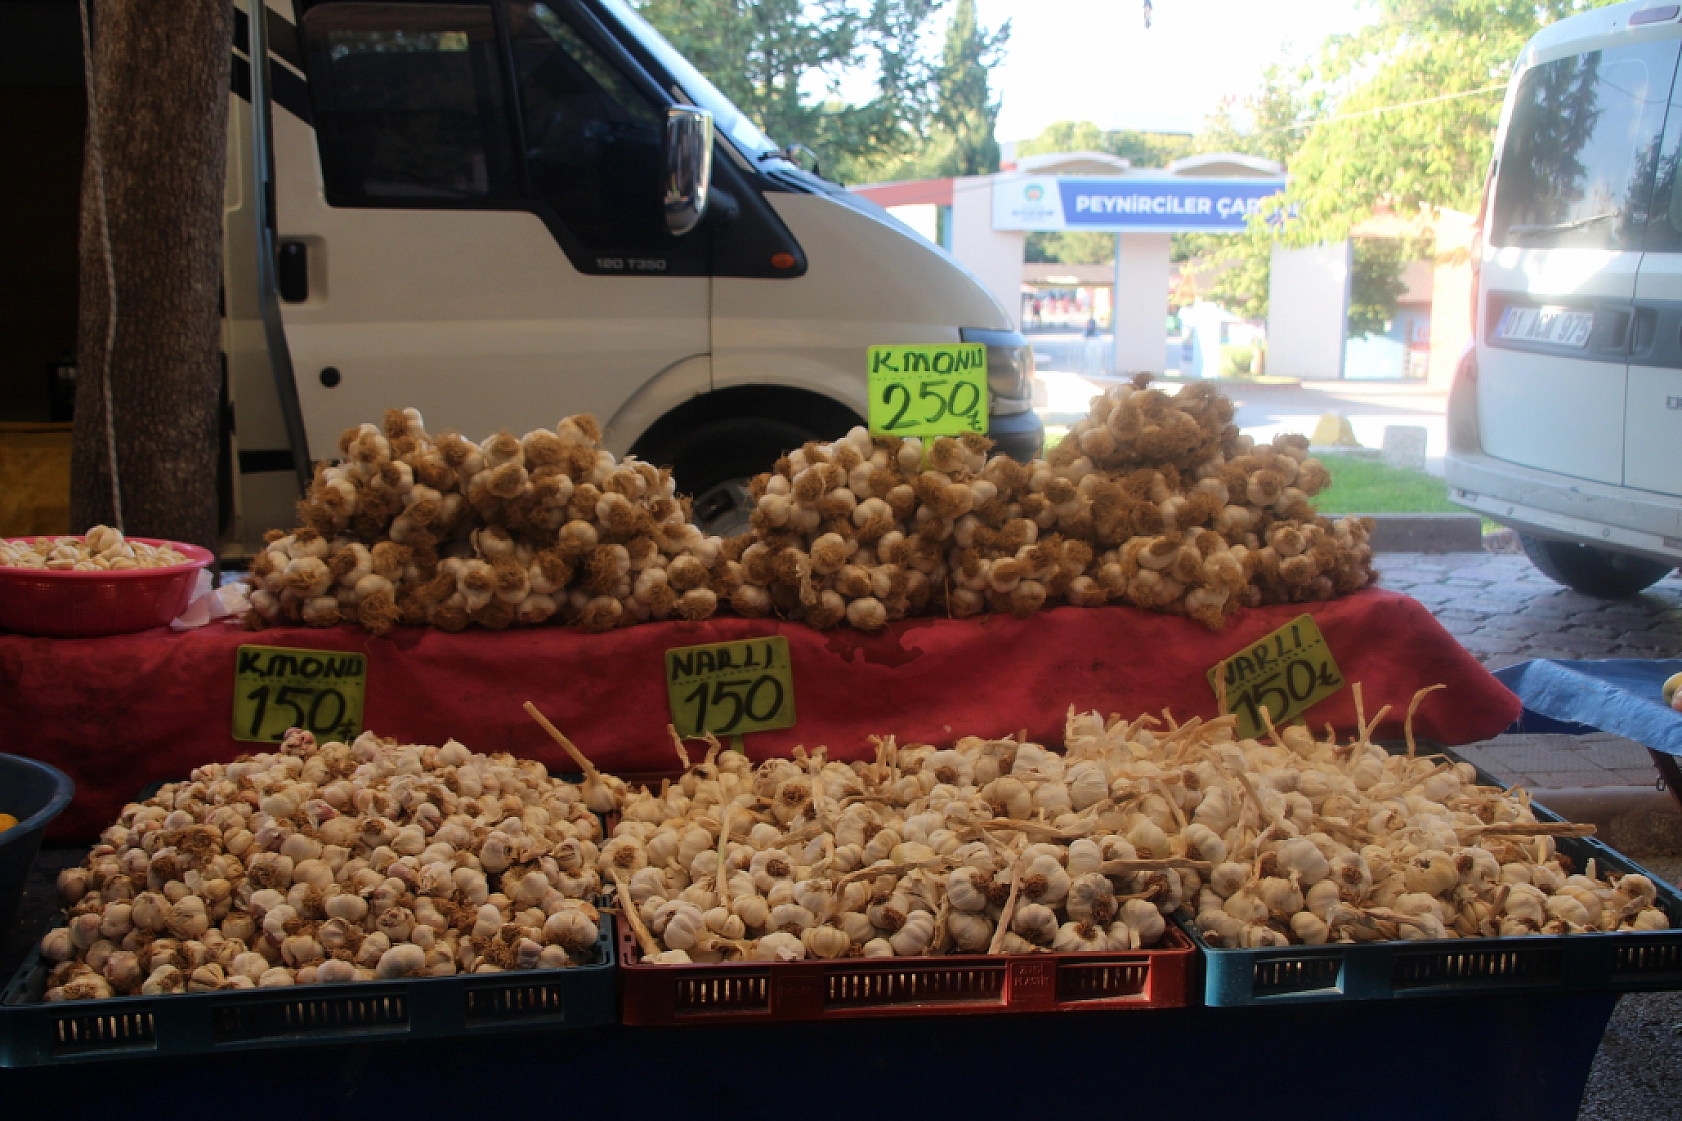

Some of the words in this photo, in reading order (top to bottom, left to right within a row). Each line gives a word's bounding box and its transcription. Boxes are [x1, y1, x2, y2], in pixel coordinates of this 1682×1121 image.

[1075, 193, 1212, 215] PEYNİRCİLER
[1558, 313, 1592, 343] 975
[672, 643, 773, 681] NARLI
[684, 674, 783, 733] 150
